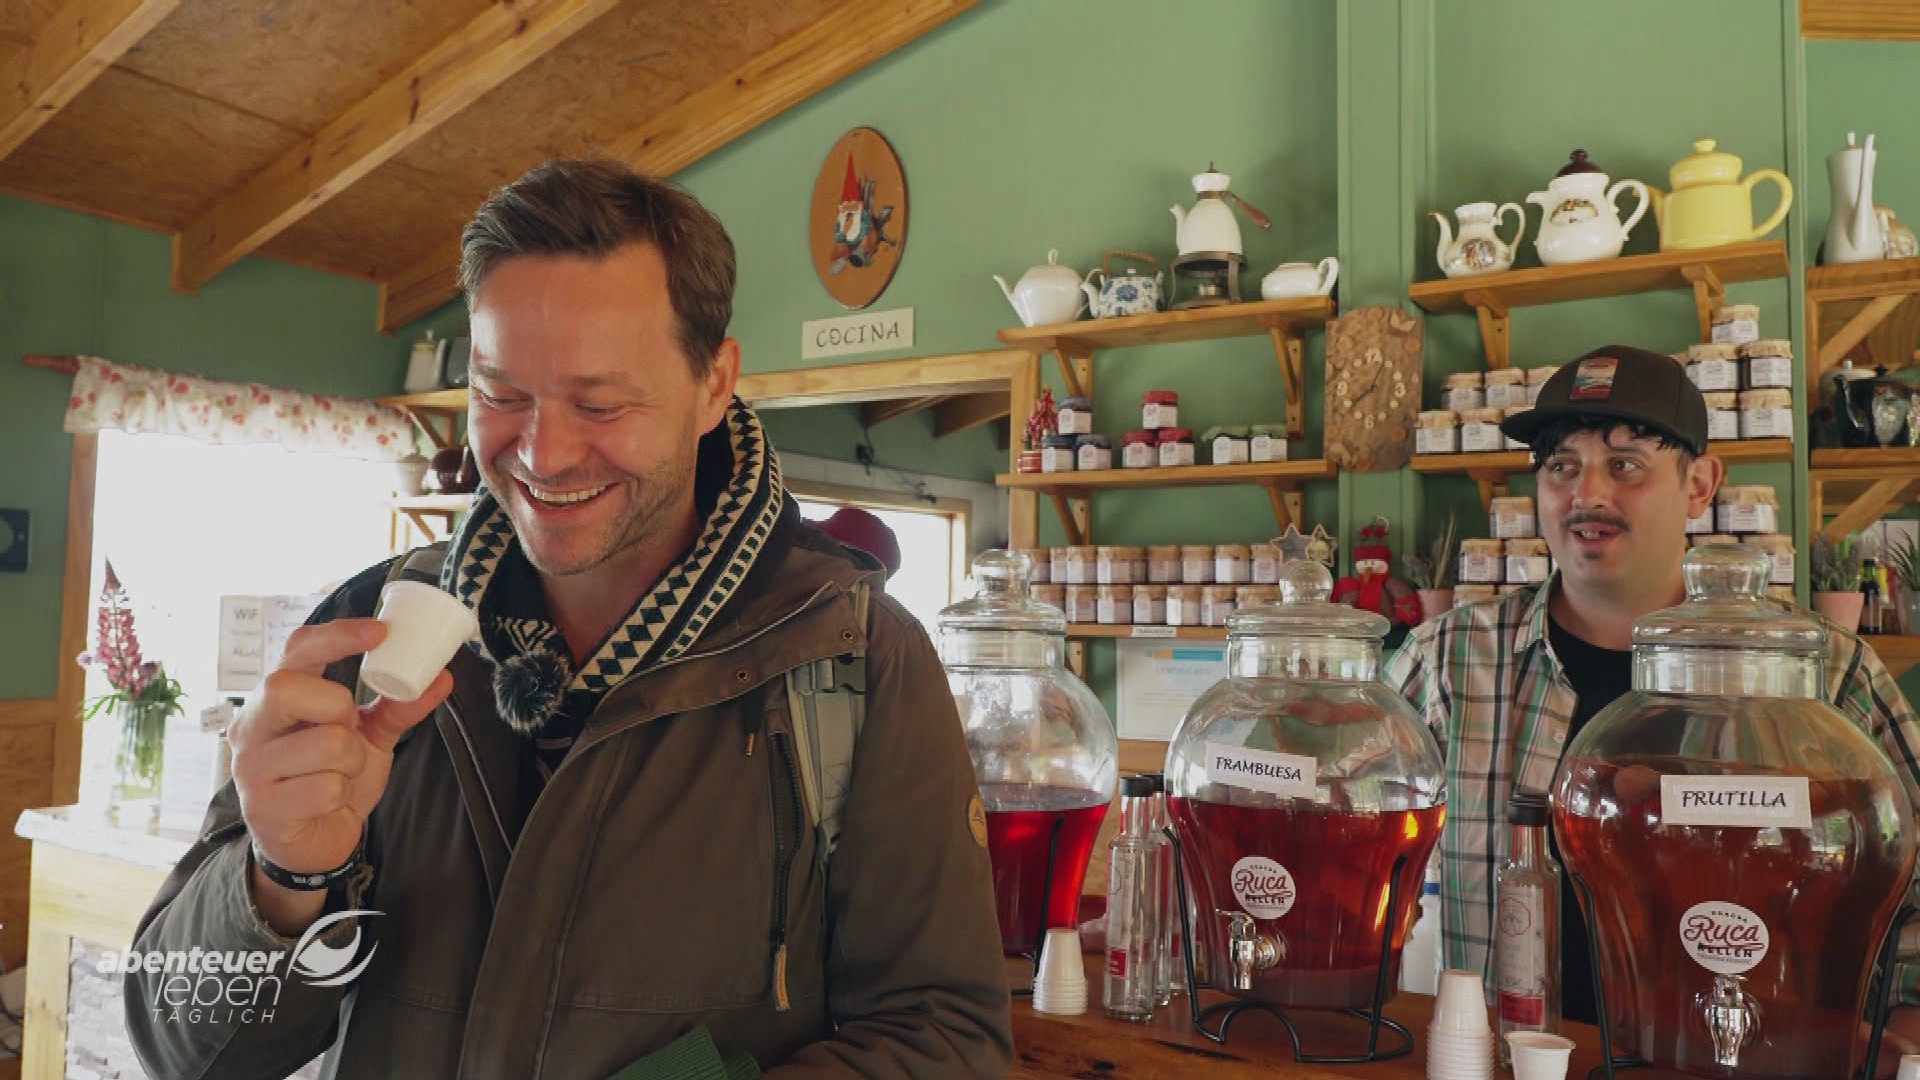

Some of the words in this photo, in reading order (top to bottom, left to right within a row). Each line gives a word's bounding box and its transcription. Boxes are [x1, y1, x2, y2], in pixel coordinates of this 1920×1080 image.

[815, 321, 900, 348] COCINA
[1215, 756, 1302, 782] FRAMBUESA
[1682, 790, 1787, 808] FRUTILLA
[1234, 868, 1288, 894] Ruca
[1683, 914, 1761, 944] Ruca
